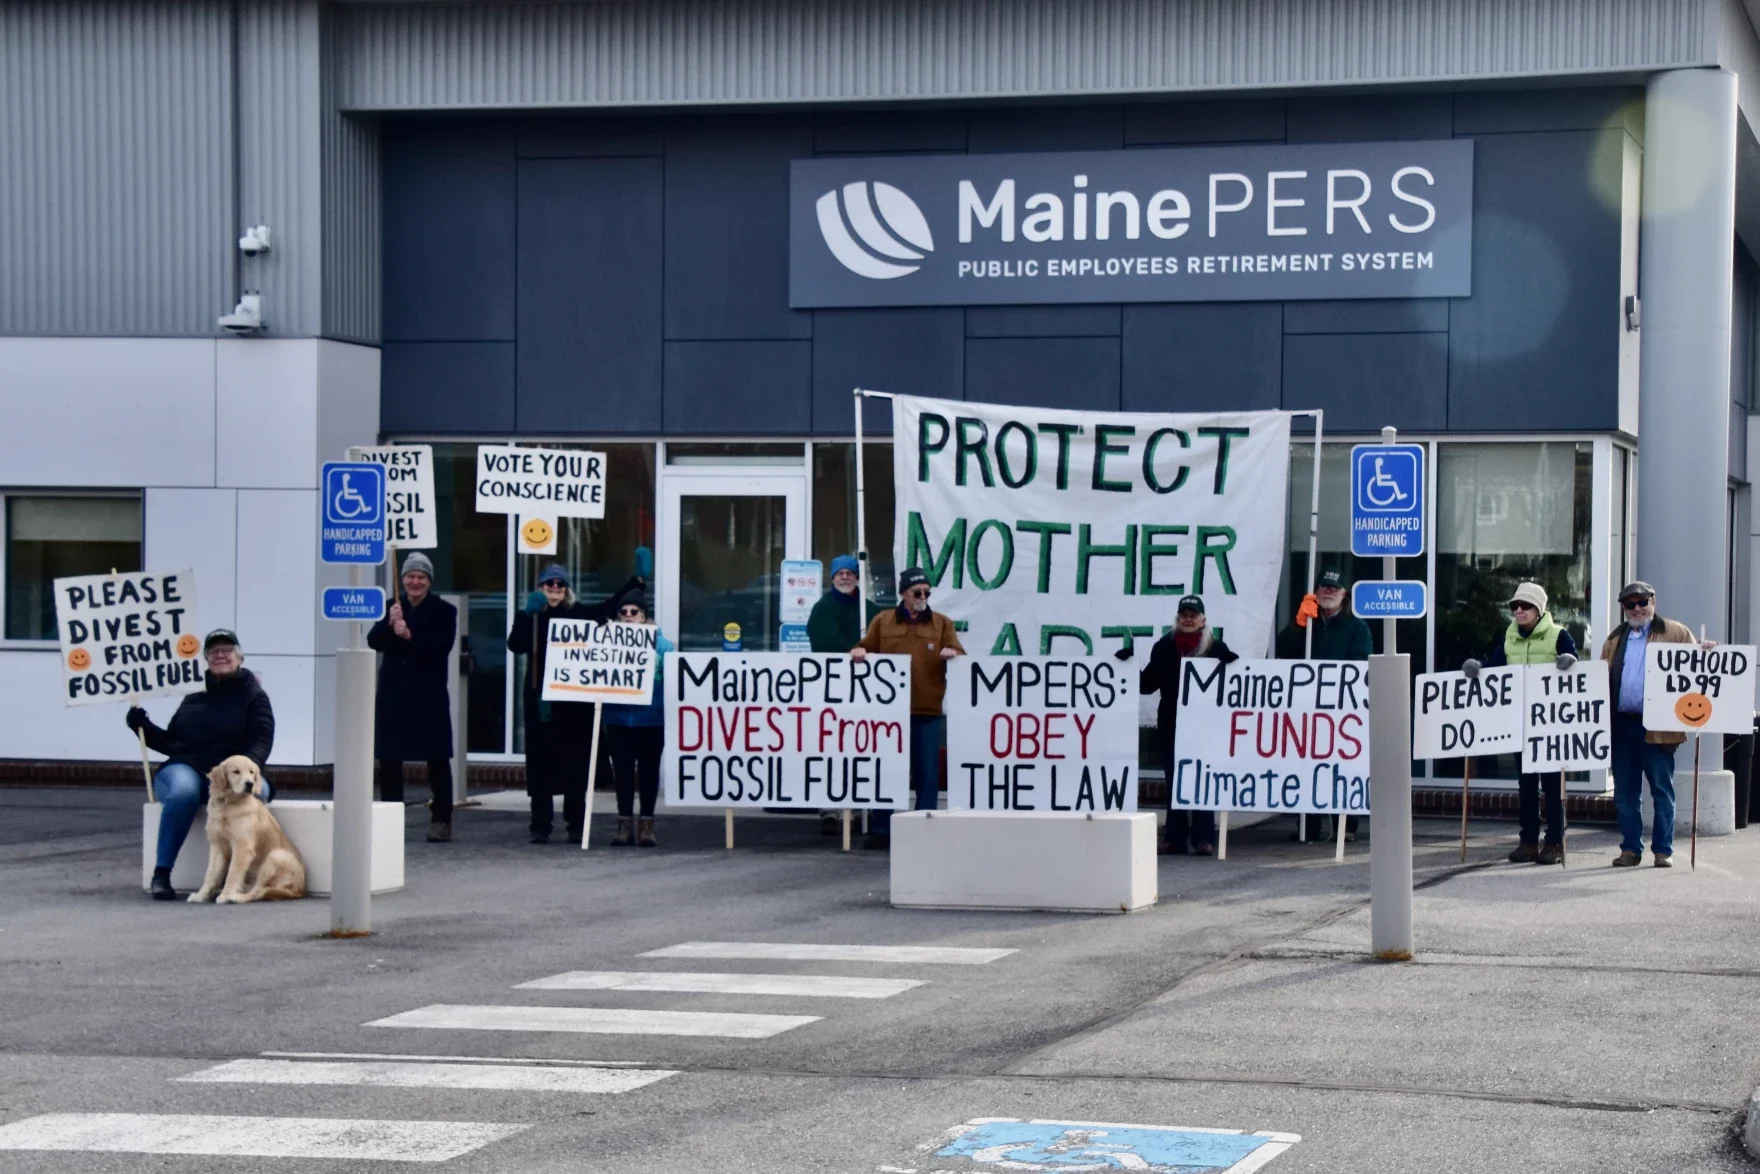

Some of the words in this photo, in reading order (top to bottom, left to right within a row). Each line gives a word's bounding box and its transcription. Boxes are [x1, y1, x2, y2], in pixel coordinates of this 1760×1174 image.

[957, 260, 1039, 278] PUBLIC
[1046, 258, 1179, 276] EMPLOYEES
[1187, 255, 1334, 272] RETIREMENT
[1341, 252, 1434, 270] SYSTEM
[485, 454, 534, 473] VOTE
[539, 454, 601, 479] YOUR
[918, 412, 1250, 495] PROTECT
[387, 468, 417, 481] OM
[479, 480, 601, 504] CONSCIENCE
[324, 528, 382, 541] HANDICAPPED
[1355, 518, 1419, 531] HANDICAPPED
[334, 544, 372, 557] PARKING
[906, 511, 1238, 596] MOTHER
[1367, 534, 1406, 547] PARKING
[65, 576, 181, 610] PLEASE
[342, 593, 365, 604] VAN
[1364, 602, 1415, 610] ACCESSIBLE
[1377, 589, 1402, 600] VAN
[331, 605, 376, 614] ACCESSIBLE
[68, 608, 185, 644] DIVEST
[551, 624, 590, 643] LOW
[592, 624, 657, 650] CARBON
[104, 639, 172, 665] FROM
[563, 648, 649, 666] INVESTING
[1657, 650, 1748, 676] UPHOLD
[69, 667, 152, 698] FOSSIL
[156, 659, 203, 687] FUEL
[554, 669, 570, 682] IS
[580, 670, 646, 689] SMART
[678, 656, 906, 704] MainePERS:
[971, 661, 1128, 708] MPERS:
[1541, 673, 1587, 696] THE
[1422, 673, 1514, 714] PLEASE
[1531, 700, 1604, 726] RIGHT
[678, 706, 811, 753] DIVEST
[990, 713, 1096, 759] OBEY
[1229, 711, 1363, 760] FUNDS
[1528, 730, 1609, 762] THING
[678, 755, 792, 801] FOSSIL
[805, 757, 893, 803] FUEL
[961, 763, 1035, 810] THE
[1050, 765, 1129, 811] LAW
[1176, 759, 1300, 809] Climate
[1311, 763, 1369, 810] Cha
